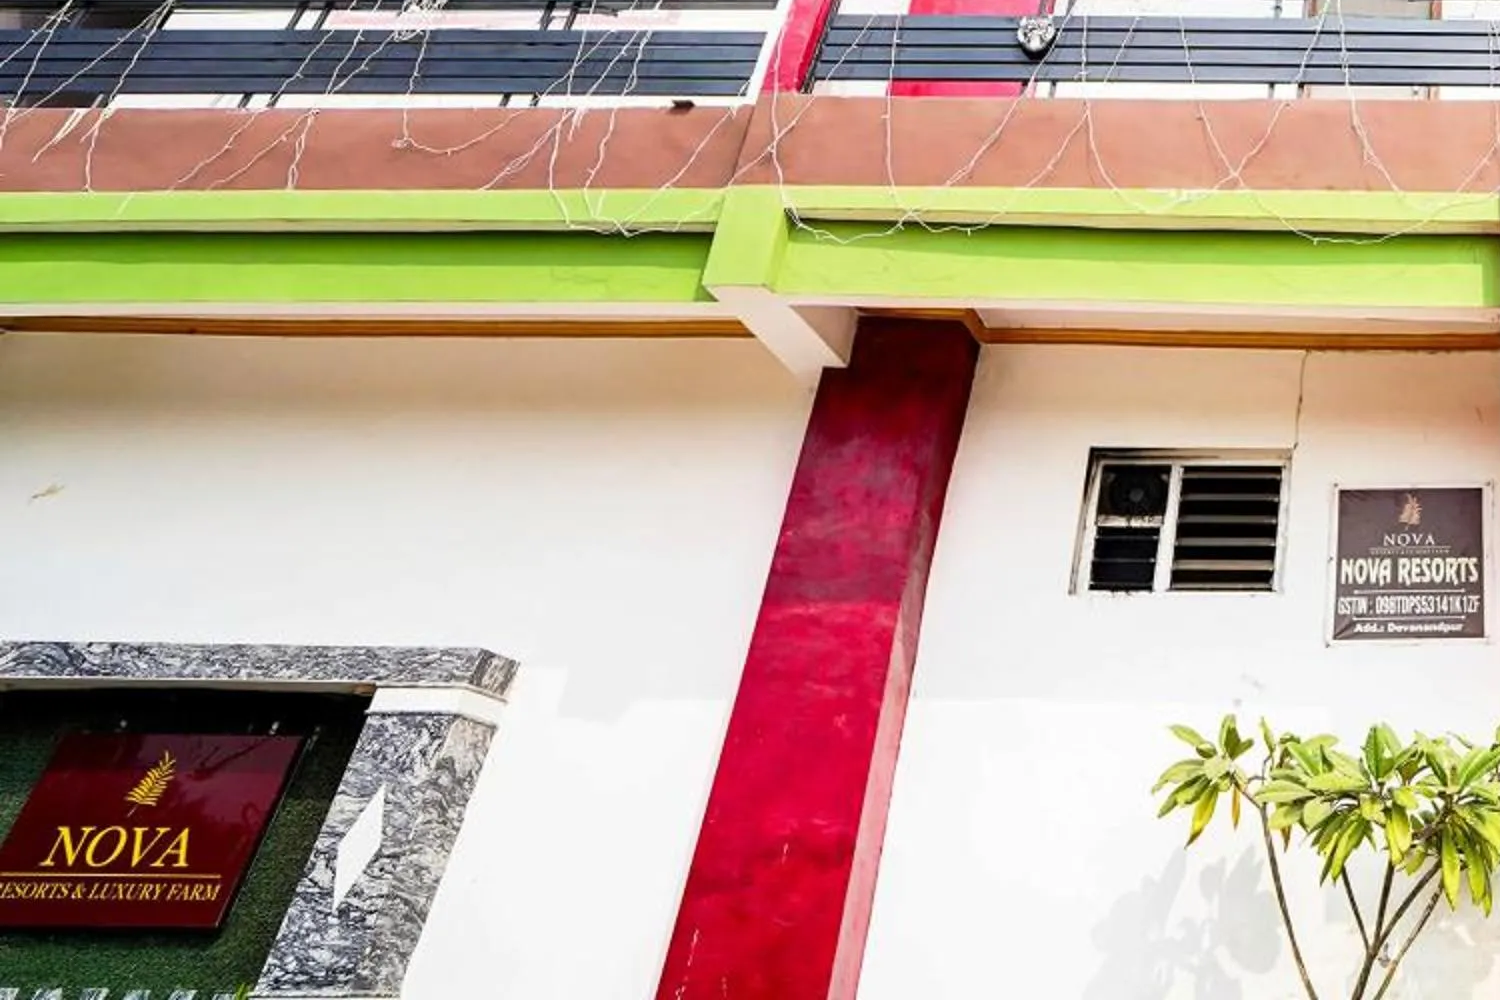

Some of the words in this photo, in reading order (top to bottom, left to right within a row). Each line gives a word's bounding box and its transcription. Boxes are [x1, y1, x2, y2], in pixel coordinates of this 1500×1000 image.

[1383, 533, 1435, 546] NOVA
[1341, 557, 1392, 586] NOVA
[1398, 557, 1479, 586] RESORTS
[38, 825, 190, 867] NOVA
[0, 882, 71, 899] ESORTS
[71, 883, 86, 899] &
[88, 883, 167, 900] LUXURY
[167, 884, 221, 900] FARM
